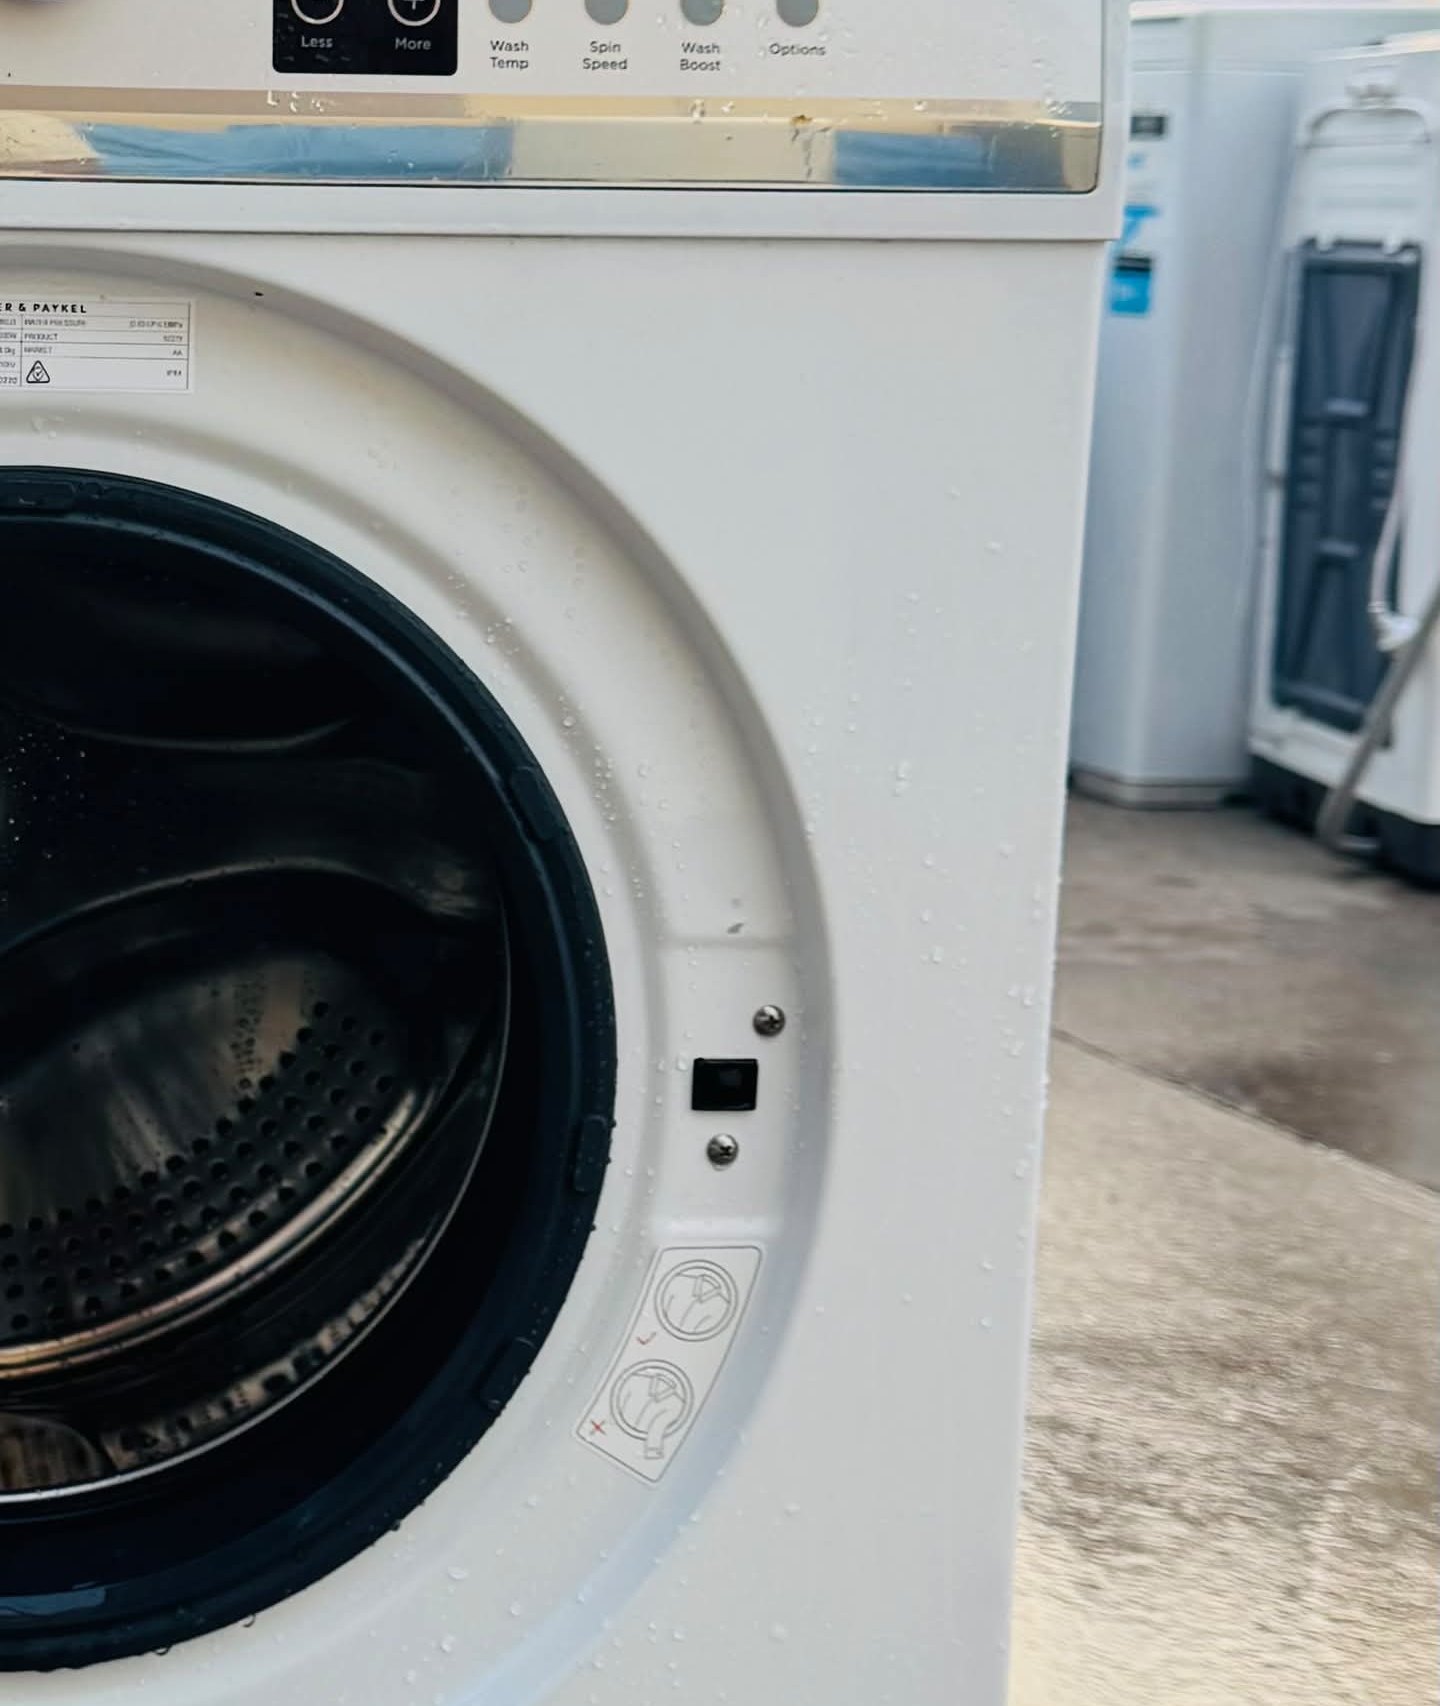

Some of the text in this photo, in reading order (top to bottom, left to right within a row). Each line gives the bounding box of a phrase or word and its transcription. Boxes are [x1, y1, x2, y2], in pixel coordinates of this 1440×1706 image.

[301, 36, 333, 48] Less
[395, 38, 431, 50] More
[490, 40, 529, 52] Wash
[590, 41, 621, 54] Spin
[681, 42, 720, 54] Wash
[769, 43, 826, 56] Options
[490, 57, 529, 70] Temp
[582, 58, 627, 71] Speed
[680, 59, 720, 71] Boost
[19, 304, 26, 312] &
[33, 304, 87, 314] PAYKEL
